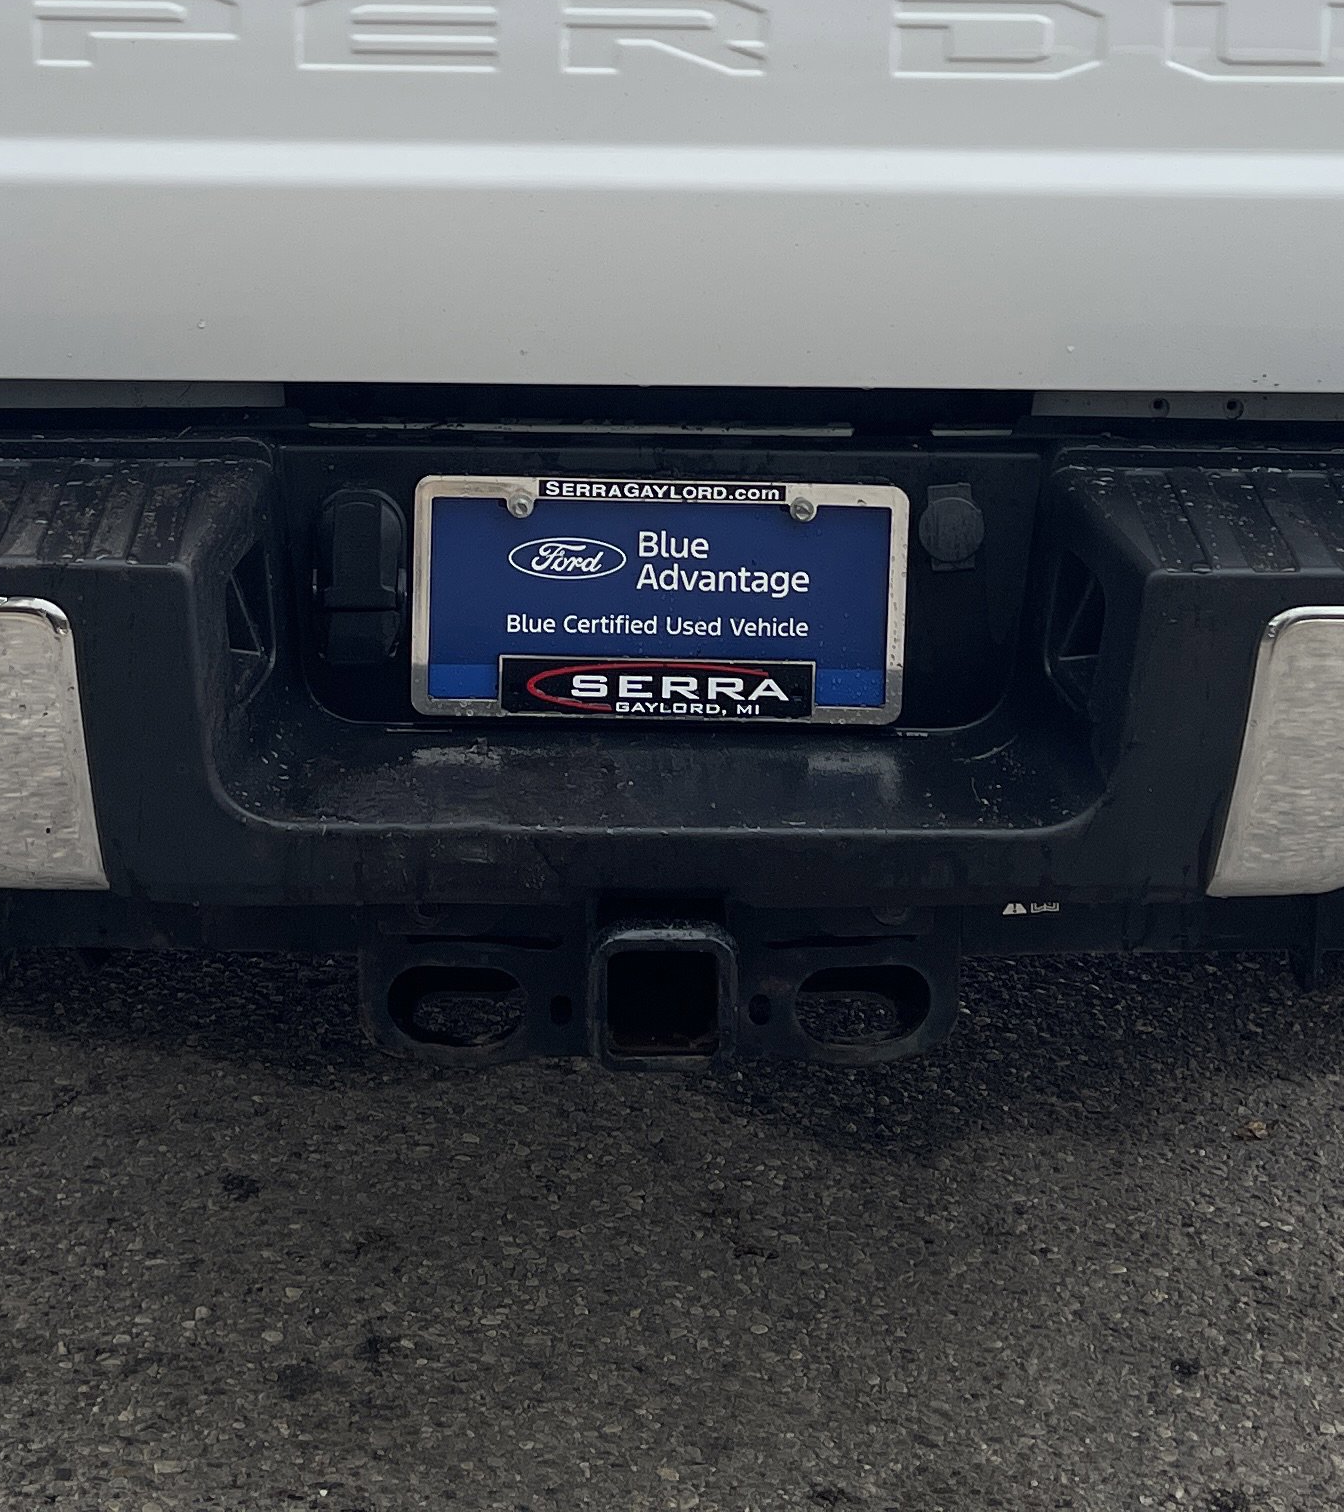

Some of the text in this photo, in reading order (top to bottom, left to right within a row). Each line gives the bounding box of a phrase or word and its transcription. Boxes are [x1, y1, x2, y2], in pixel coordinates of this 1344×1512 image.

[544, 480, 781, 501] SERRAGAYLORD.com
[531, 542, 603, 573] Ford
[638, 530, 710, 559] Blue
[636, 564, 811, 599] Advantage
[506, 614, 809, 638] Blue Certified Used Vehicle
[570, 674, 790, 702] SERRA
[615, 701, 760, 716] GAYLORD, MI
